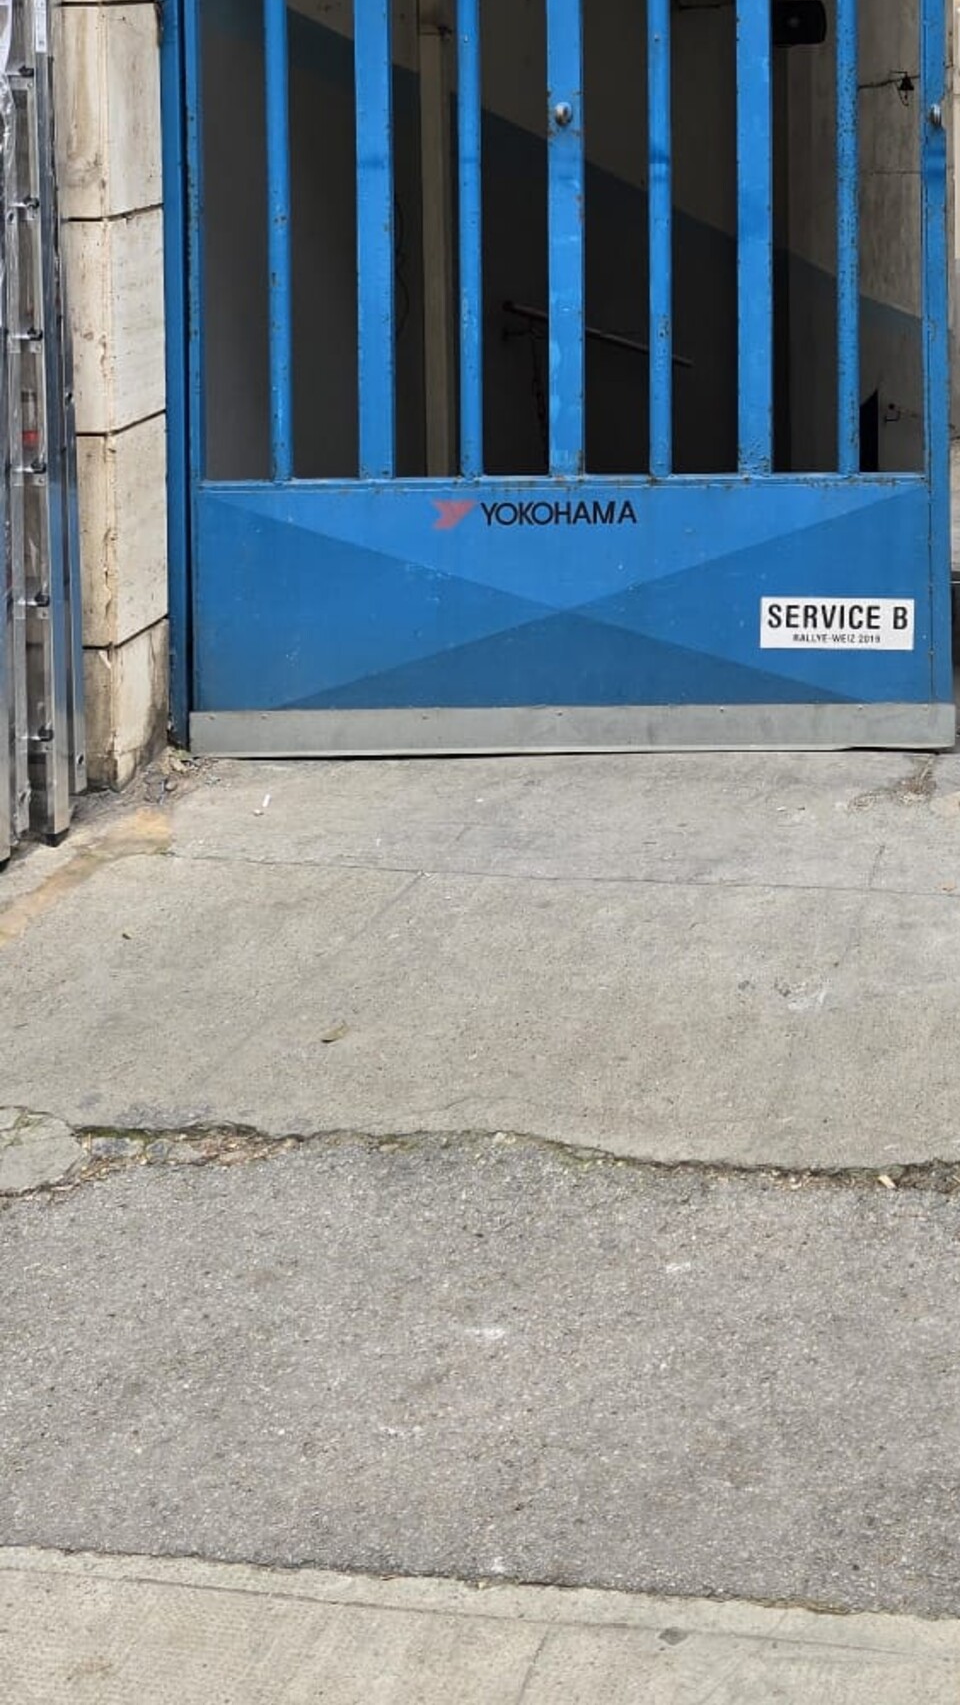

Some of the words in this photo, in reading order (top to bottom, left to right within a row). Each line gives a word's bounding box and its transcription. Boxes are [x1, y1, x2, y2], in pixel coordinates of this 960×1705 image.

[480, 500, 637, 527] YOKOHAMA
[768, 604, 881, 630] SERVICE
[893, 606, 908, 630] B
